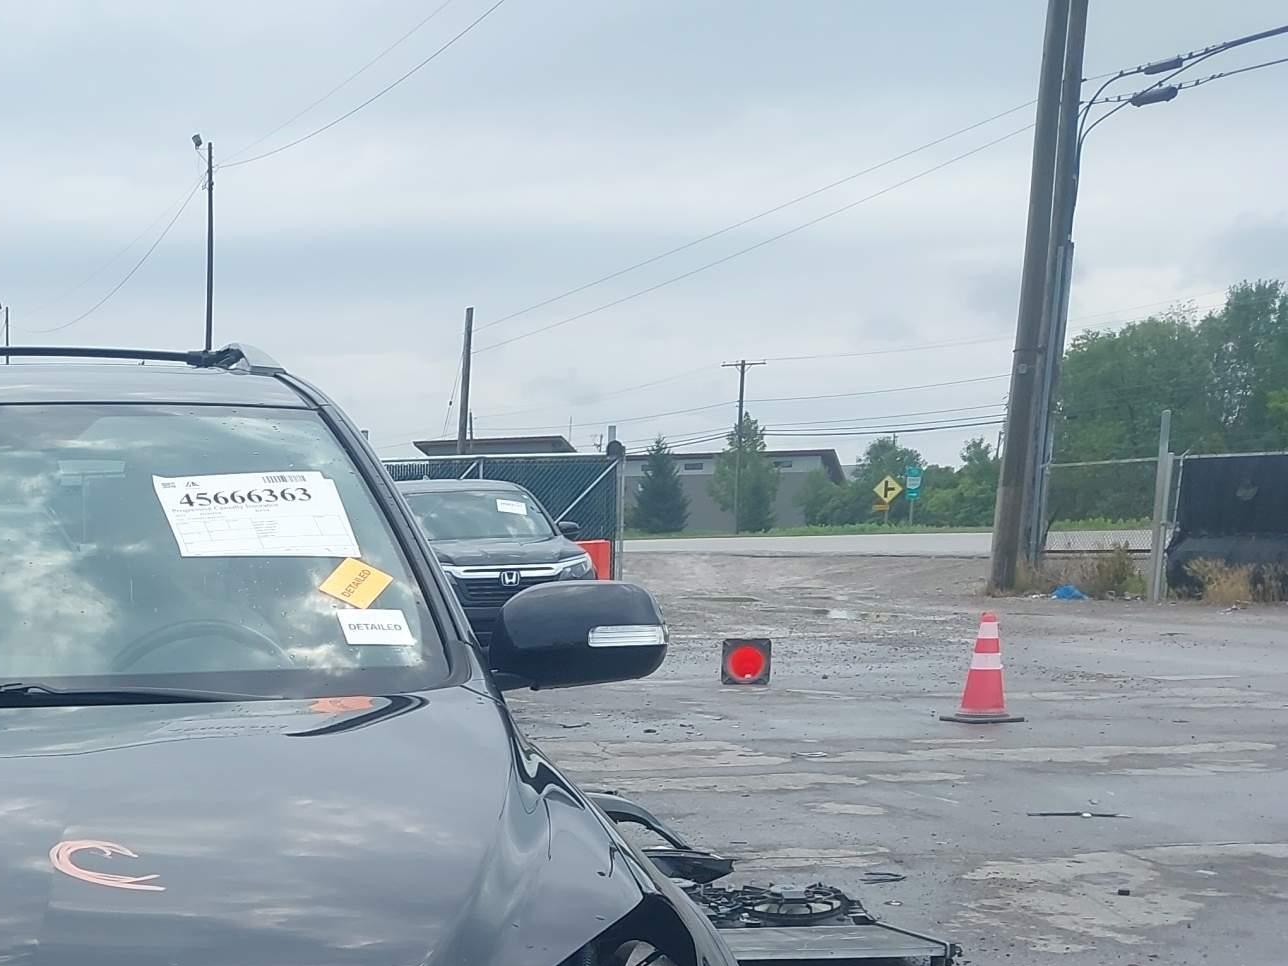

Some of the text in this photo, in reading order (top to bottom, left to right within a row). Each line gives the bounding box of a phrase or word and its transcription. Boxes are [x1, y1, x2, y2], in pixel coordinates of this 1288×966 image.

[179, 487, 312, 507] 45666363
[341, 569, 372, 598] DETAILED
[348, 623, 402, 631] DETAILED
